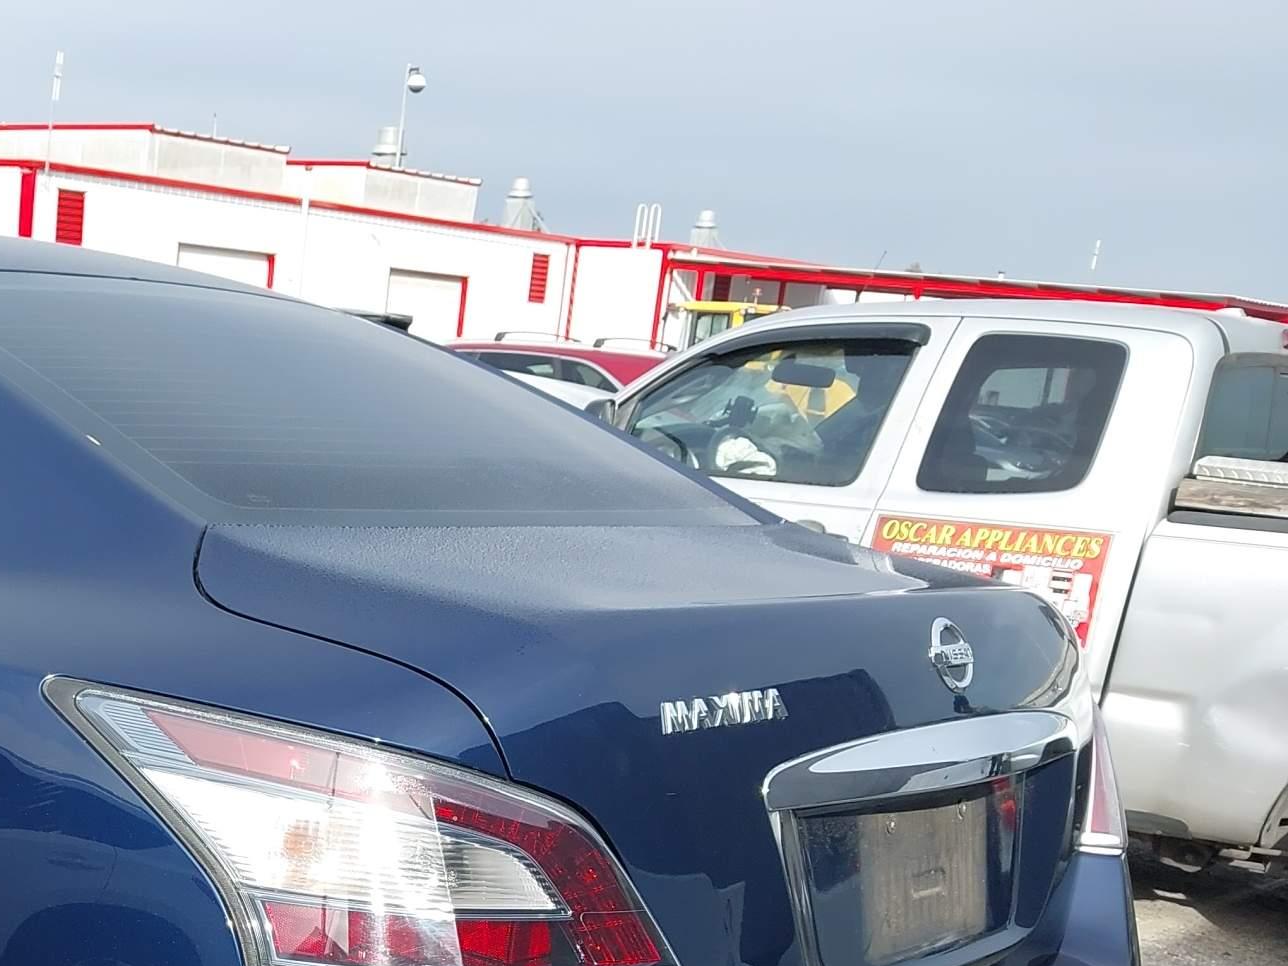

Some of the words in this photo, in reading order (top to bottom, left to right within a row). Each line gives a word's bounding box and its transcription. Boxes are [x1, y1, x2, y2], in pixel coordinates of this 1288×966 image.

[882, 518, 953, 545] OSCAR
[956, 527, 1103, 559] APPLIANCES
[891, 541, 985, 562] REPARACION
[986, 551, 997, 562] A
[1000, 553, 1083, 570] DOMICILIO
[660, 688, 789, 735] MAXIMA
